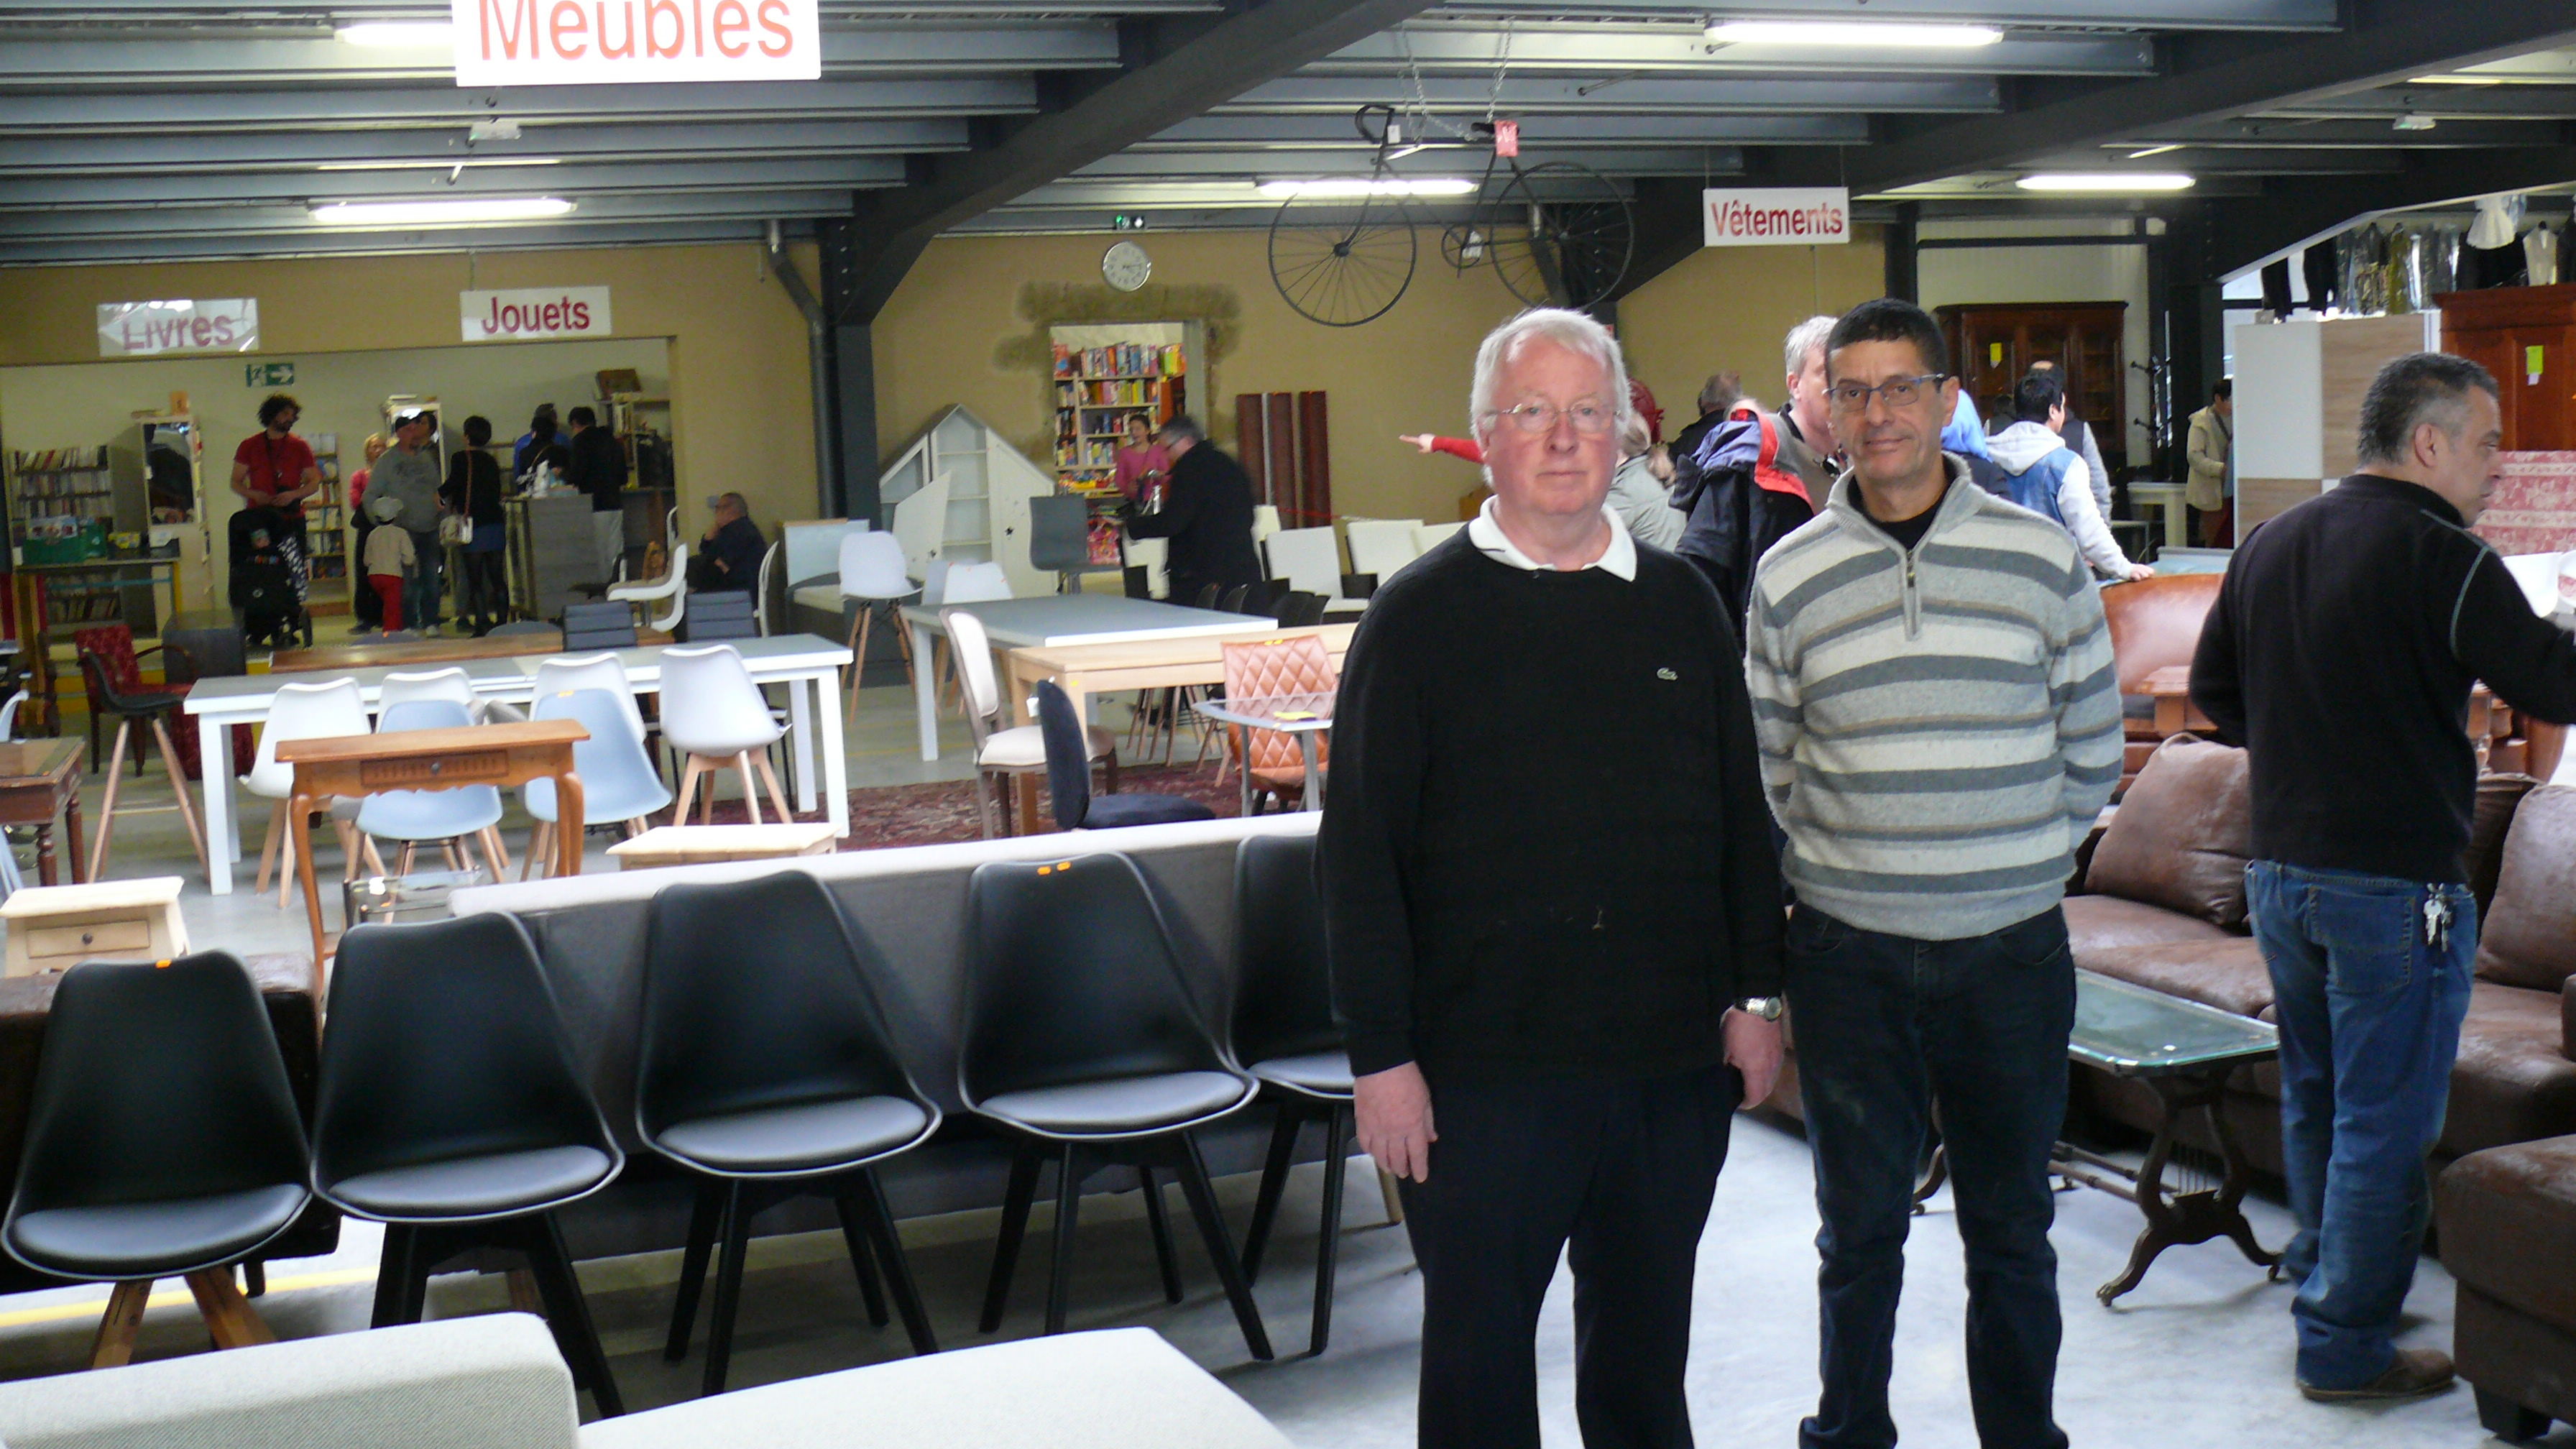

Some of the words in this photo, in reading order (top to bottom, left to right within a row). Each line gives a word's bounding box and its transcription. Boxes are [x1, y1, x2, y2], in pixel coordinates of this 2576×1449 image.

[477, 0, 794, 61] Meubles
[1711, 199, 1843, 237] Vêtements
[121, 313, 234, 350] Livres
[482, 295, 591, 334] Jouets
